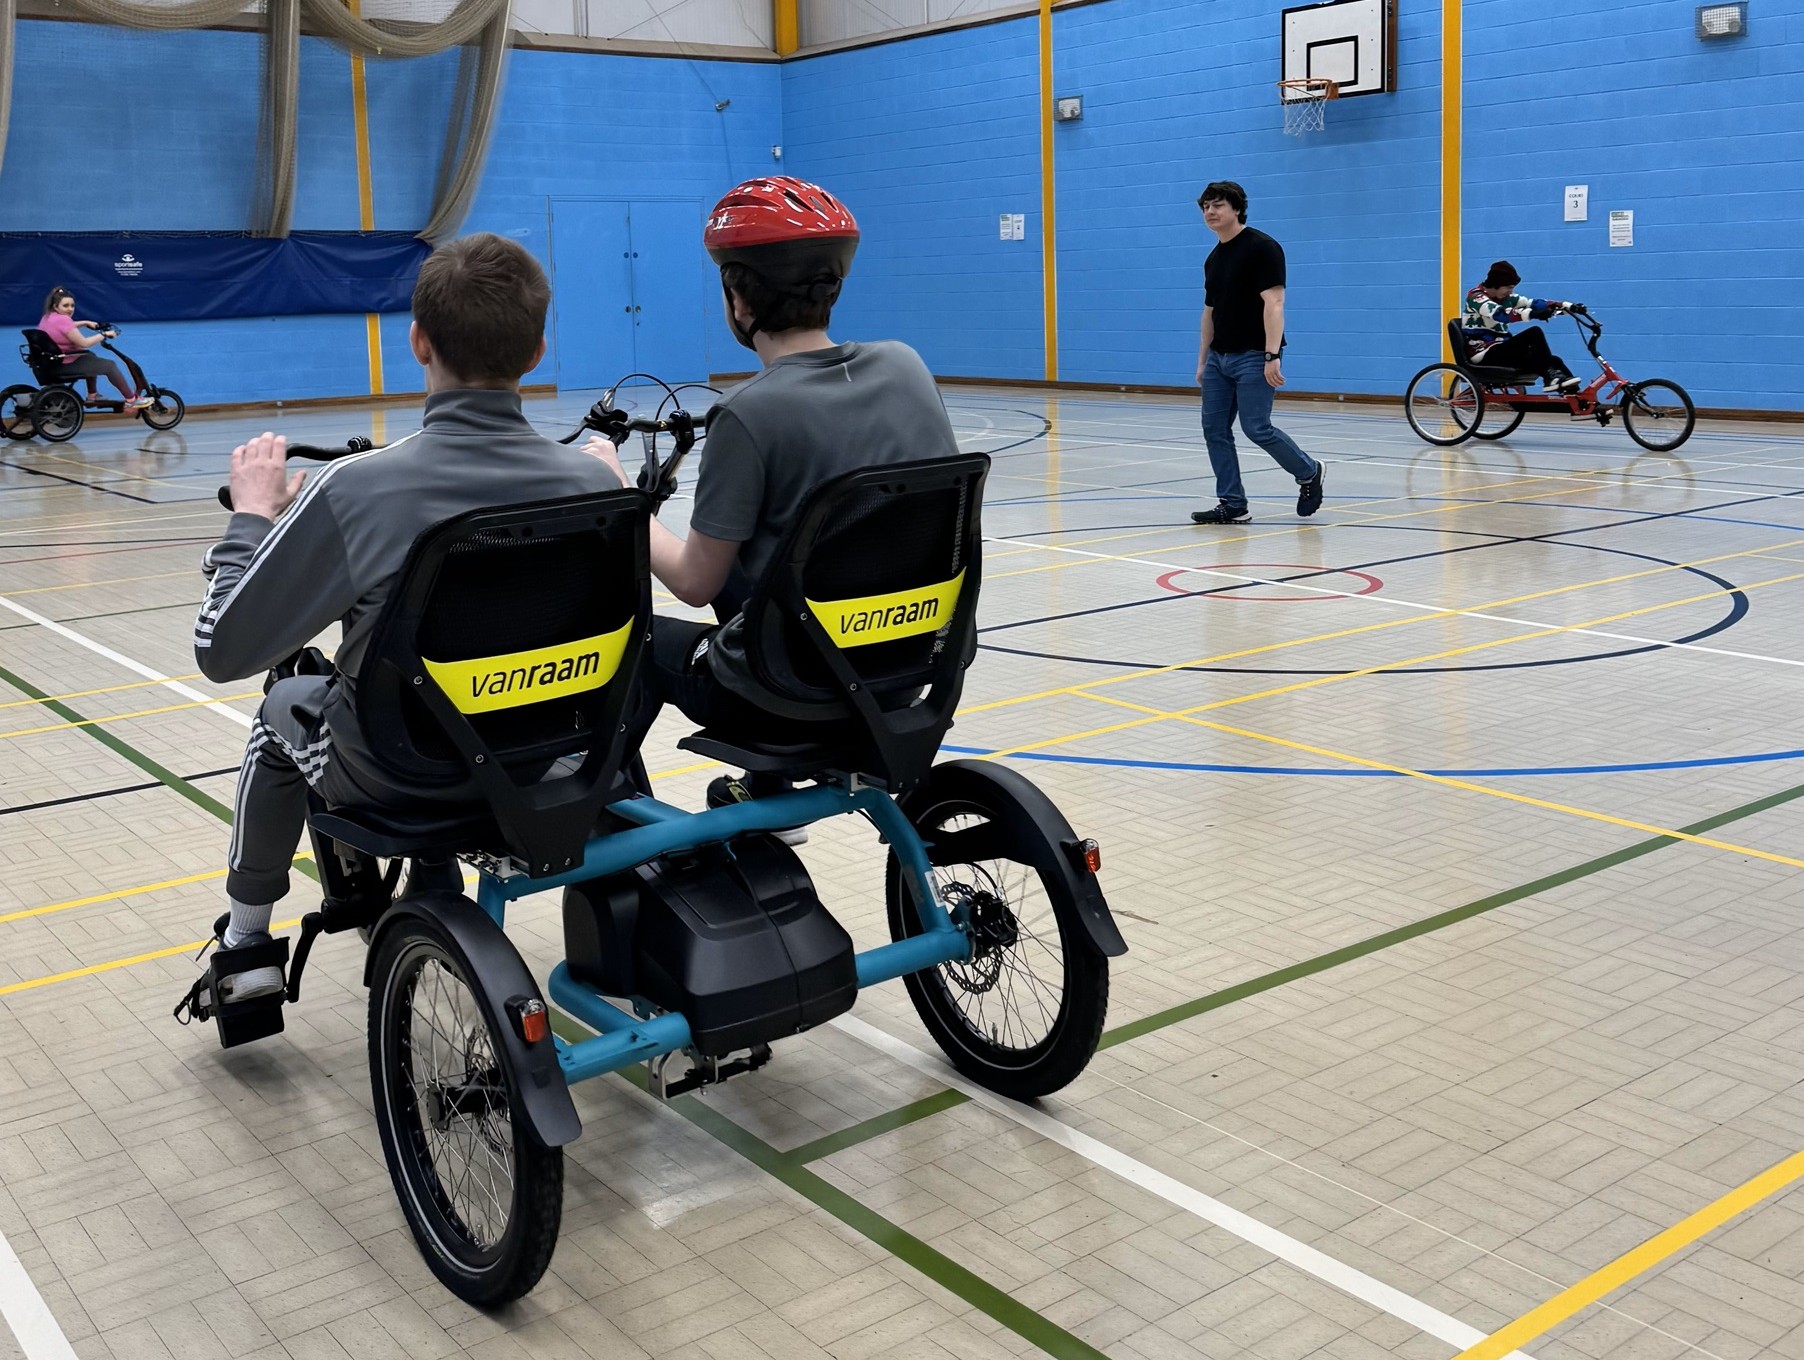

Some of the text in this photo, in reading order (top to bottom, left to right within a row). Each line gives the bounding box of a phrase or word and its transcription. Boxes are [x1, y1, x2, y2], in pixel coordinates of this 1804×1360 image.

[1573, 200, 1579, 208] 3
[841, 597, 939, 634] vanraam
[471, 651, 600, 698] vanraam
